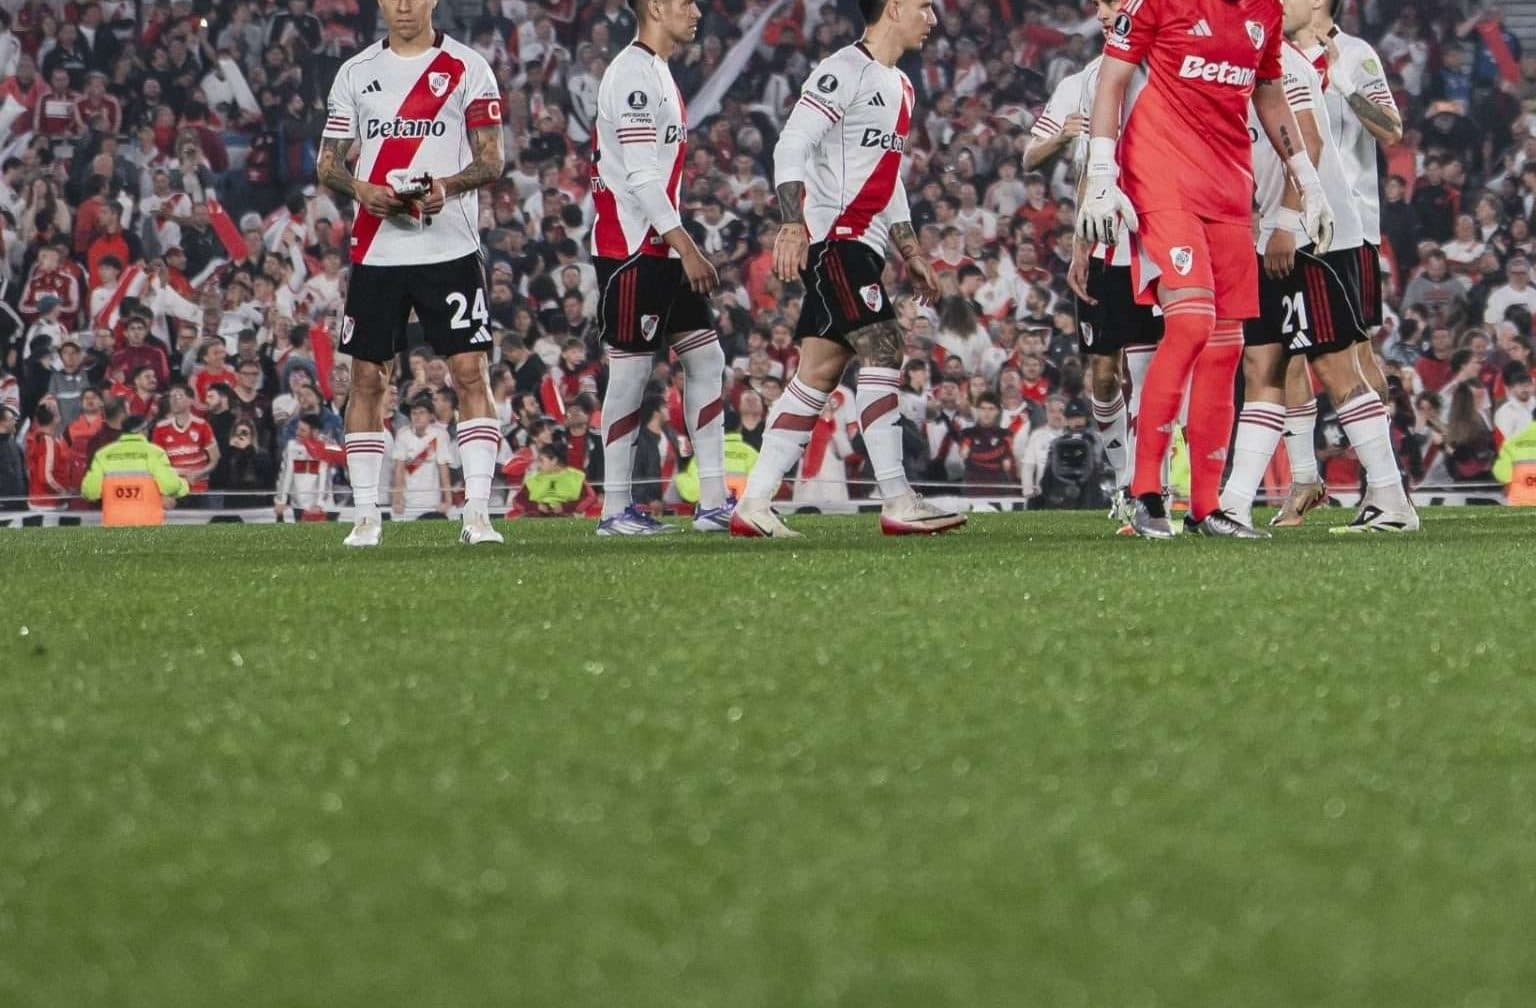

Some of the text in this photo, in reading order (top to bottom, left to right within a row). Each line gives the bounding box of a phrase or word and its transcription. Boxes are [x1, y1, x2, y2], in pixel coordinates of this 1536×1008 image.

[366, 119, 446, 140] Betano
[445, 287, 489, 330] 24
[1282, 291, 1309, 334] 21
[115, 487, 141, 499] 037
